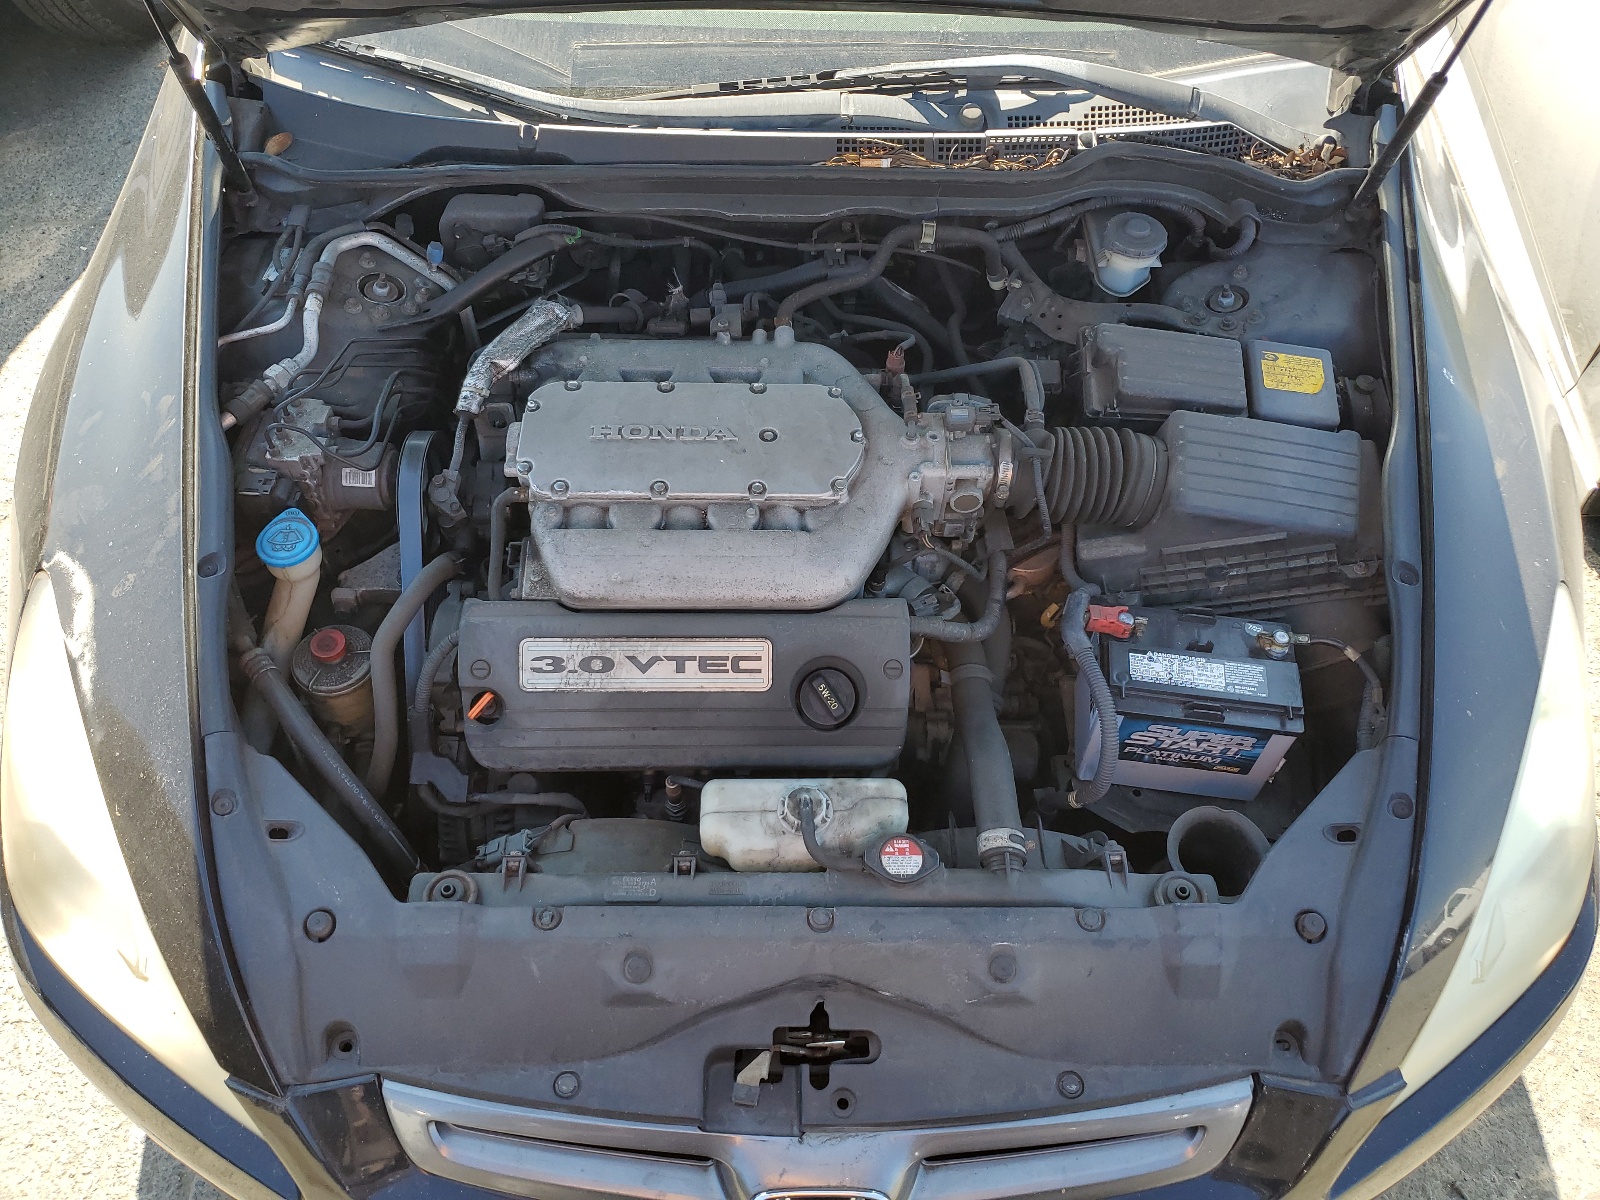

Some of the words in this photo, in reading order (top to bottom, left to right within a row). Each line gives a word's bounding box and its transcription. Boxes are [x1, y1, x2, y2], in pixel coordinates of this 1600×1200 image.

[590, 424, 739, 442] HONDA
[530, 655, 616, 674] 3.0
[625, 655, 762, 675] VTEC
[818, 683, 838, 710] 5W-20
[1124, 731, 1242, 757] START
[1147, 724, 1258, 751] SUPER
[1123, 746, 1222, 764] PLATINUM
